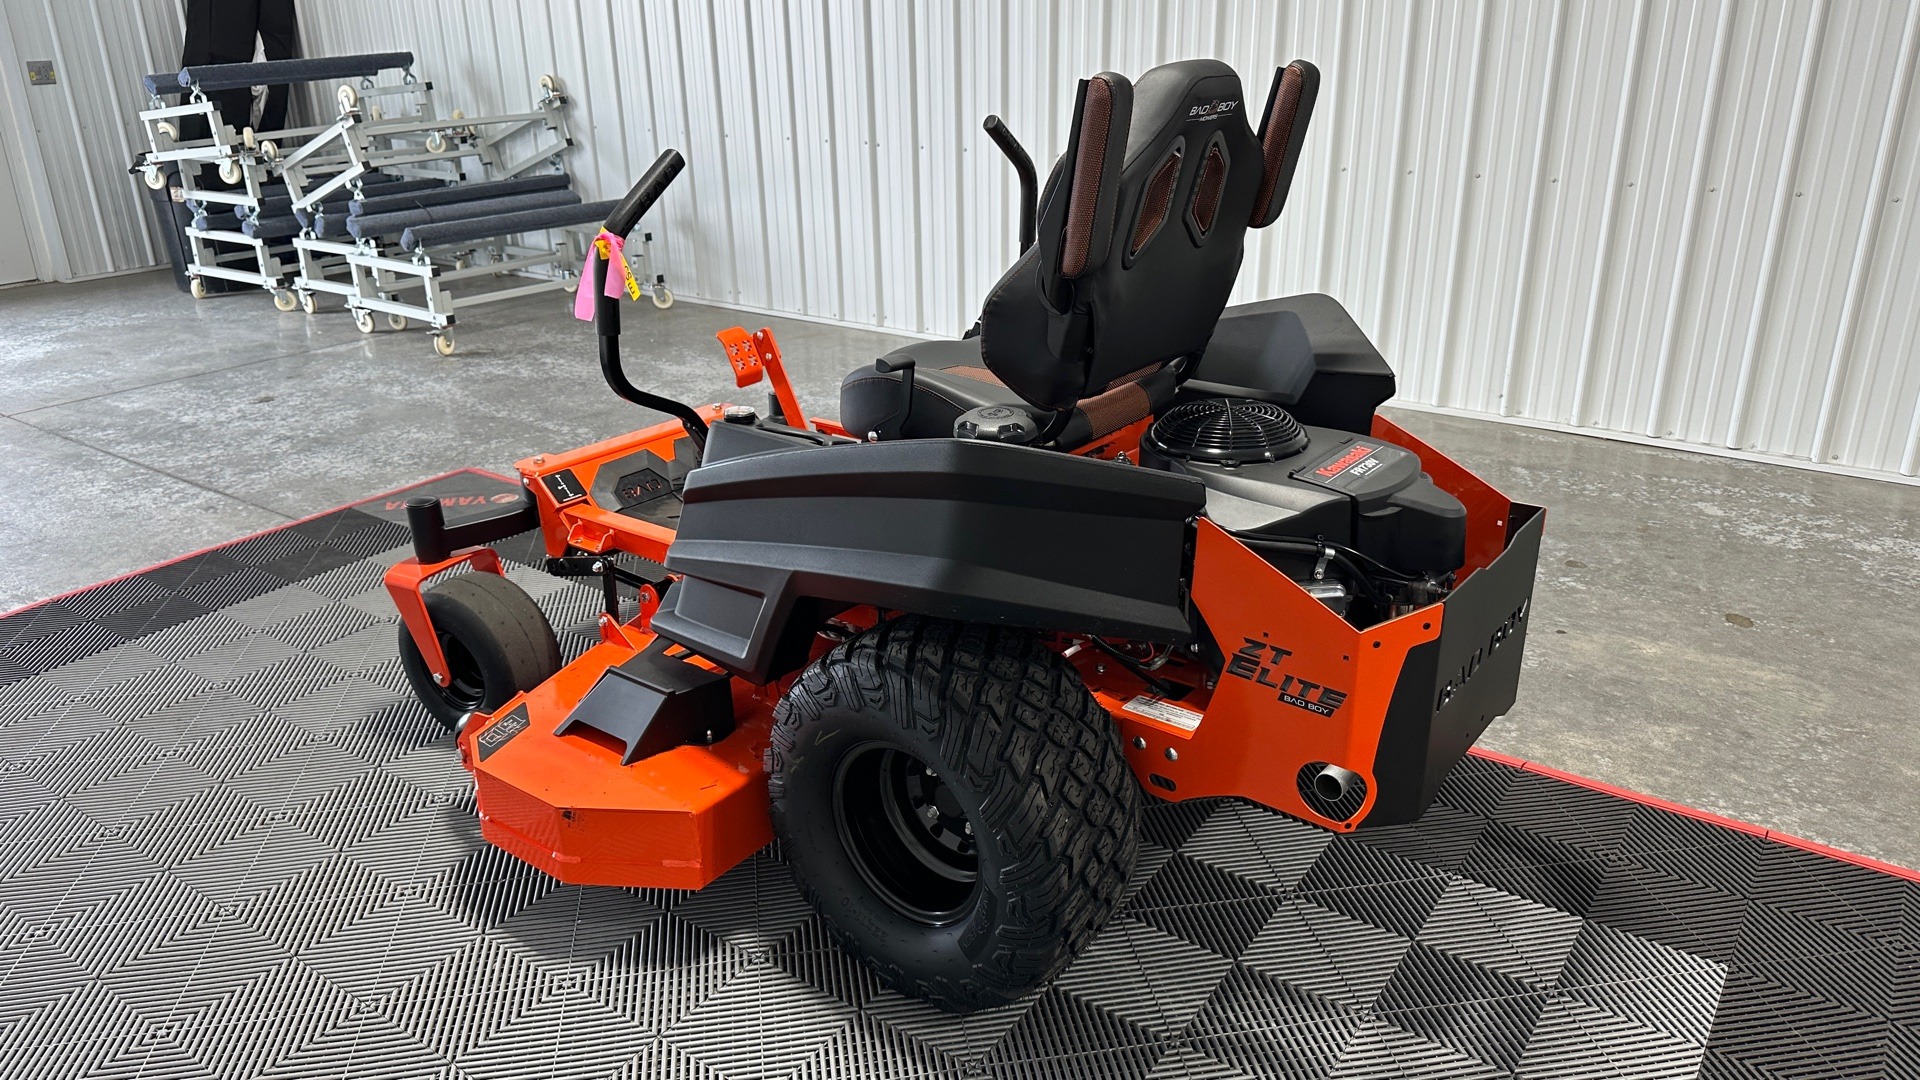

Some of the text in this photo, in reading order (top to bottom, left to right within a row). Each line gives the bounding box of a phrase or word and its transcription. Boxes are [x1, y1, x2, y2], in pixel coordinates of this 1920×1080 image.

[1189, 101, 1239, 116] BAD BOY
[1315, 445, 1373, 477] Kawasaki
[385, 495, 486, 511] YAMA
[1238, 637, 1293, 665] ZT
[1436, 597, 1531, 713] BAD BOY
[1226, 653, 1348, 710] ELITE
[1284, 695, 1329, 715] BAD BOY
